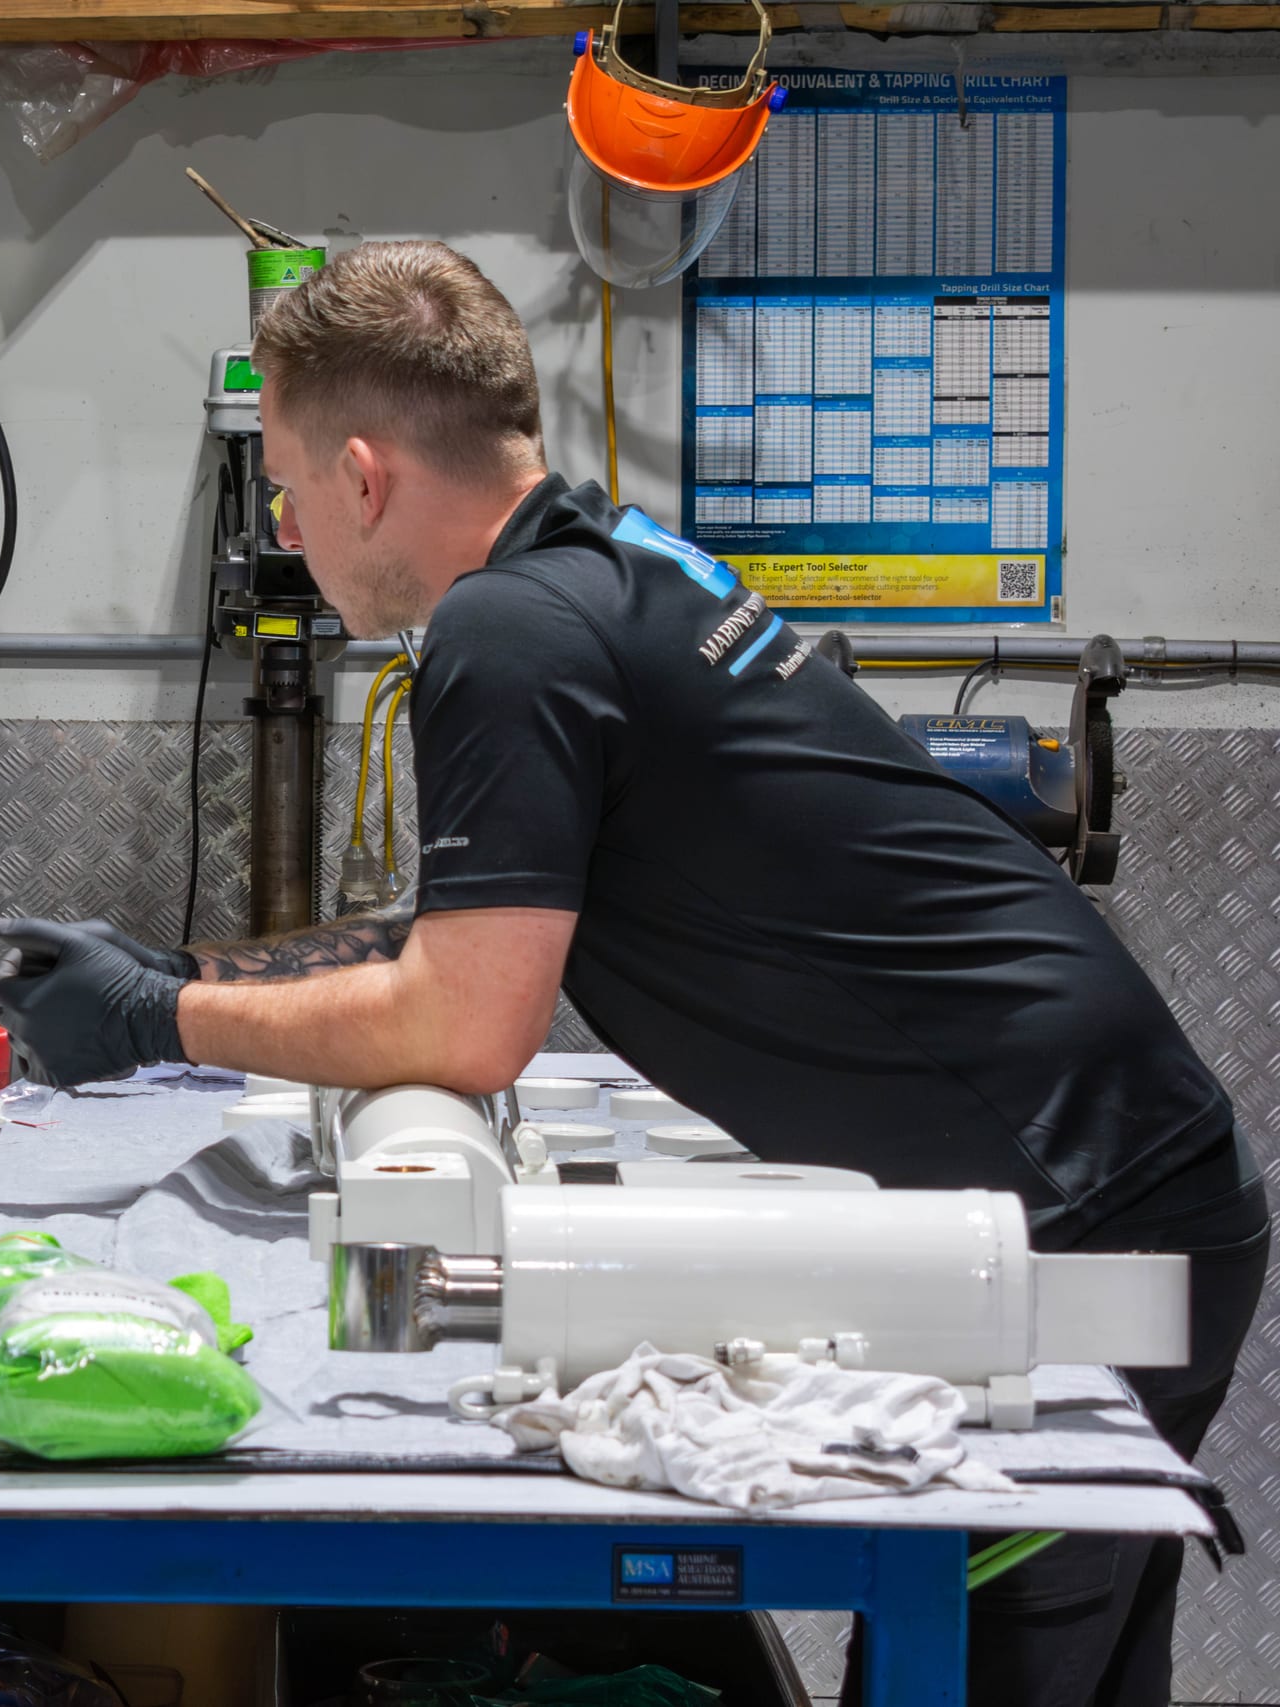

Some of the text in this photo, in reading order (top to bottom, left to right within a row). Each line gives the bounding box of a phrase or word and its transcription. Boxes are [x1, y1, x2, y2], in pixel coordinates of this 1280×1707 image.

[869, 74, 881, 88] &
[884, 74, 951, 88] TAPPING
[963, 75, 998, 87] RILL
[879, 95, 900, 105] Drill
[901, 95, 921, 105] Size
[973, 95, 1024, 106] Equivalent
[1026, 94, 1052, 105] Chart
[941, 283, 1050, 293] Tapping Drill Size Chart
[748, 562, 868, 573] ETS Expert Tool Selector
[892, 574, 908, 584] right
[698, 607, 756, 667] MARINE
[926, 718, 1007, 729] GMC
[624, 1558, 670, 1577] MSA
[677, 1564, 735, 1574] SOLUTIONS
[677, 1574, 734, 1584] AUSTRALIA
